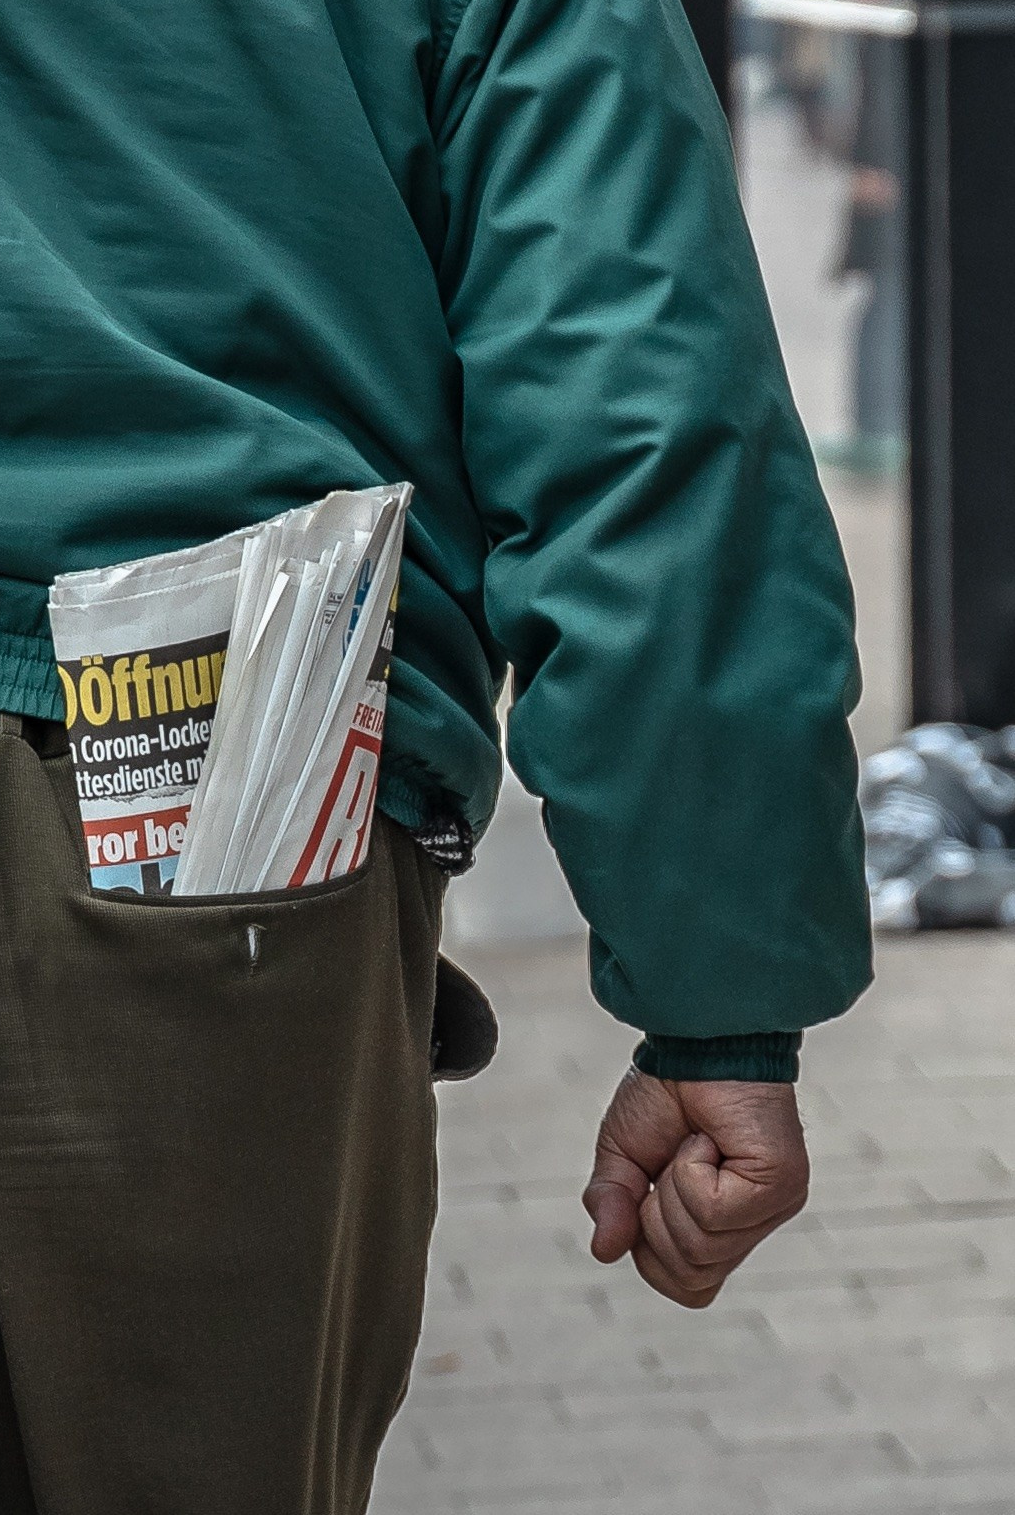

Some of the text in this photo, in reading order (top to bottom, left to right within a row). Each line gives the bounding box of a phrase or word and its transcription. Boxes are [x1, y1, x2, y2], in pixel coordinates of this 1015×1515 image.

[80, 717, 214, 764] Corona-Locke
[86, 811, 191, 865] ror be
